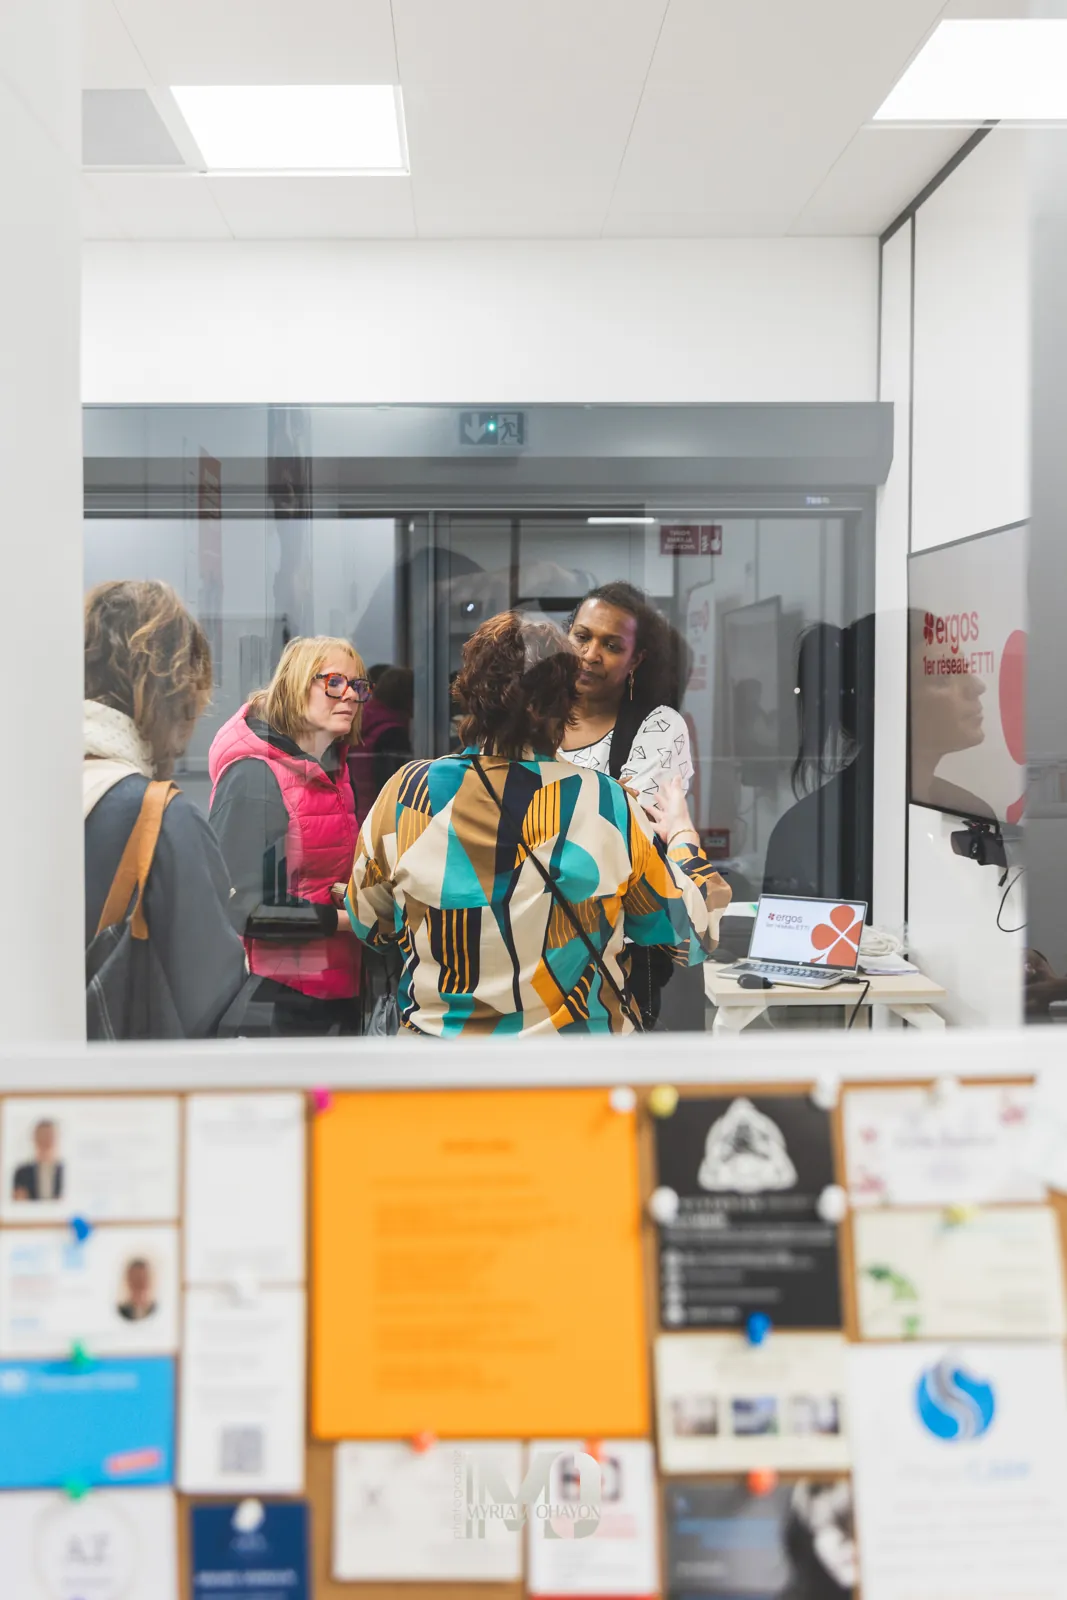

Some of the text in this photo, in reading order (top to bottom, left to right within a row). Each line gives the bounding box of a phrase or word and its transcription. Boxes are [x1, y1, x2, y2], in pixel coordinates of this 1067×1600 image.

[936, 611, 979, 655] ergos
[970, 651, 995, 674] ETTI
[776, 914, 803, 925] ergos
